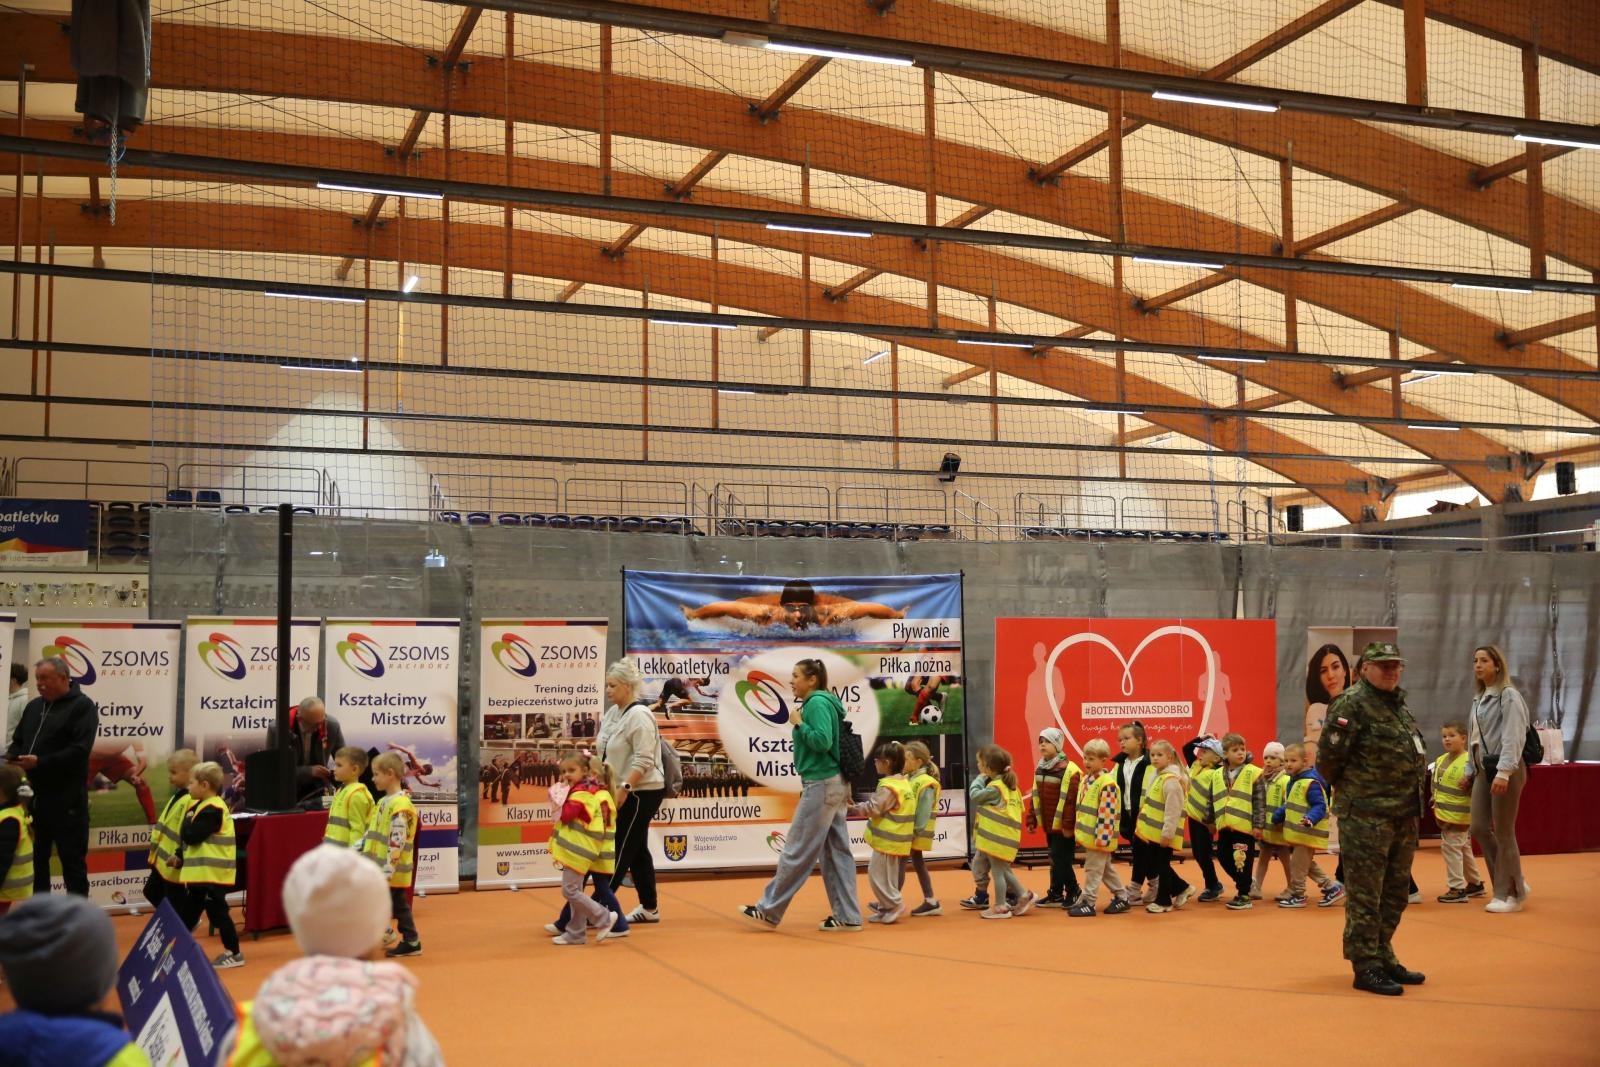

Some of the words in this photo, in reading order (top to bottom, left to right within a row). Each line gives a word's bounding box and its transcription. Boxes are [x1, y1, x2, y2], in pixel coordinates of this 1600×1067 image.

[893, 622, 950, 643] Pływanie
[101, 650, 169, 667] ZSOMS
[389, 646, 450, 661] ZSOMS
[540, 645, 598, 660] ZSOMS
[880, 657, 911, 673] Piłka
[914, 657, 951, 673] nożna
[534, 684, 574, 695] Trening
[576, 683, 599, 694] dziś,
[200, 695, 277, 710] Kształcim
[339, 692, 427, 709] Kształcimy
[488, 697, 573, 708] bezpieczeństwo
[574, 697, 599, 708] jutra
[1085, 704, 1190, 715] #BOTETNIWNASDOBRO
[371, 712, 446, 726] Mistrzów
[98, 722, 164, 737] istrzów
[507, 806, 534, 822] Klasy
[679, 801, 762, 820] mundurowe
[98, 830, 128, 846] Piłka
